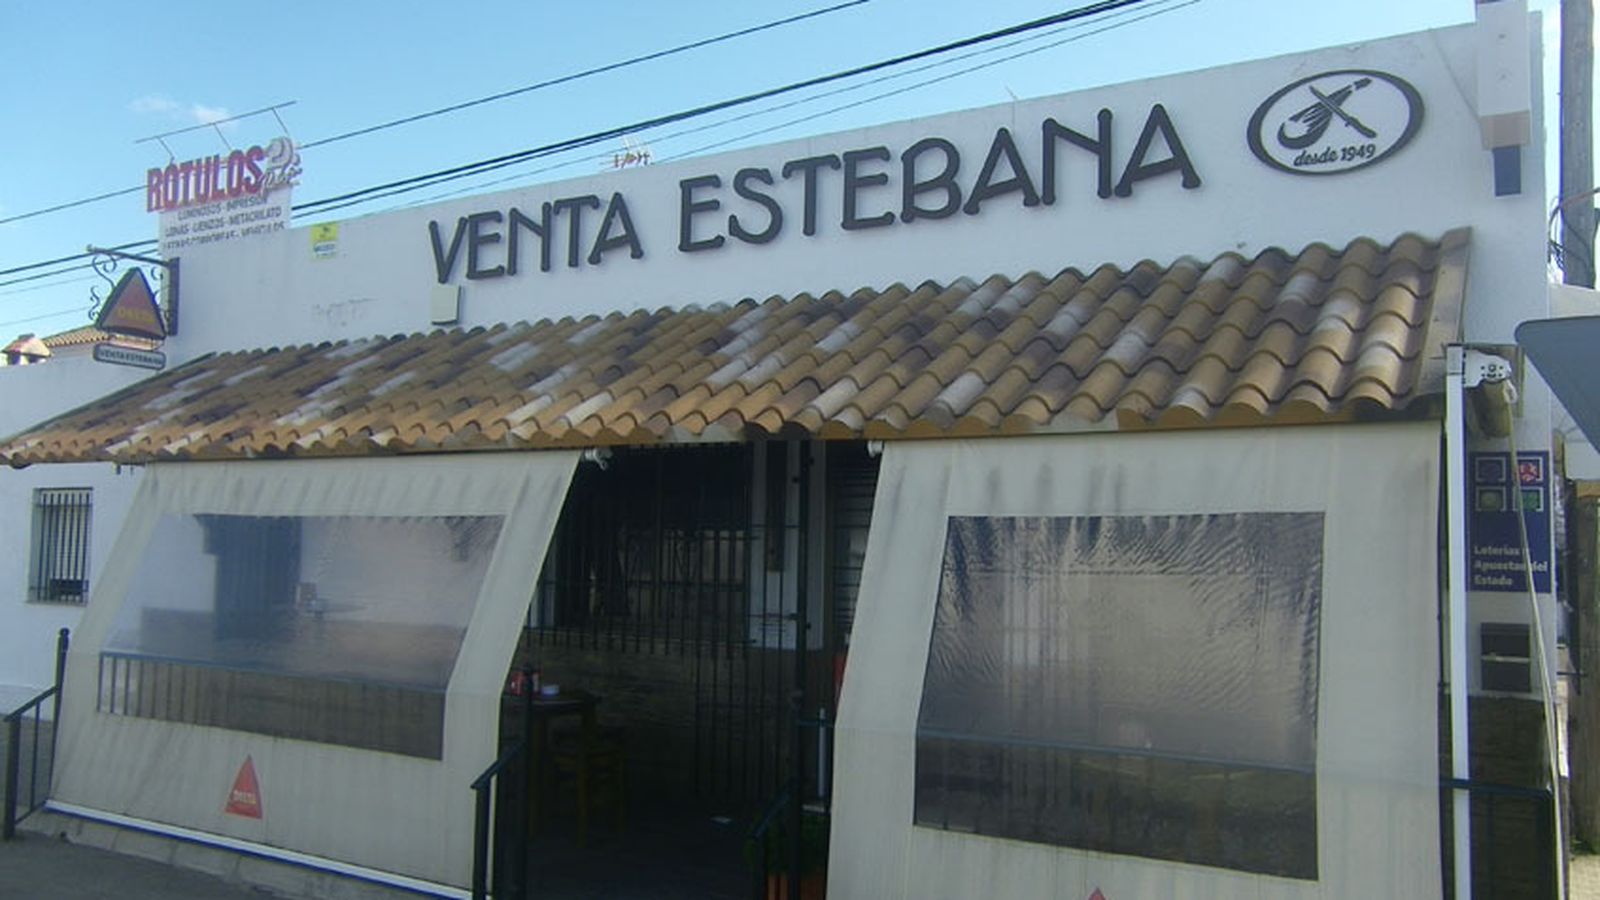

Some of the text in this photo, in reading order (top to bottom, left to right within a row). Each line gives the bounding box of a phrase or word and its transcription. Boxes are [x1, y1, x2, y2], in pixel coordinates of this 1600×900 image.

[428, 103, 1202, 284] VENTA ESTEBANA
[1293, 143, 1377, 167] desde 1949
